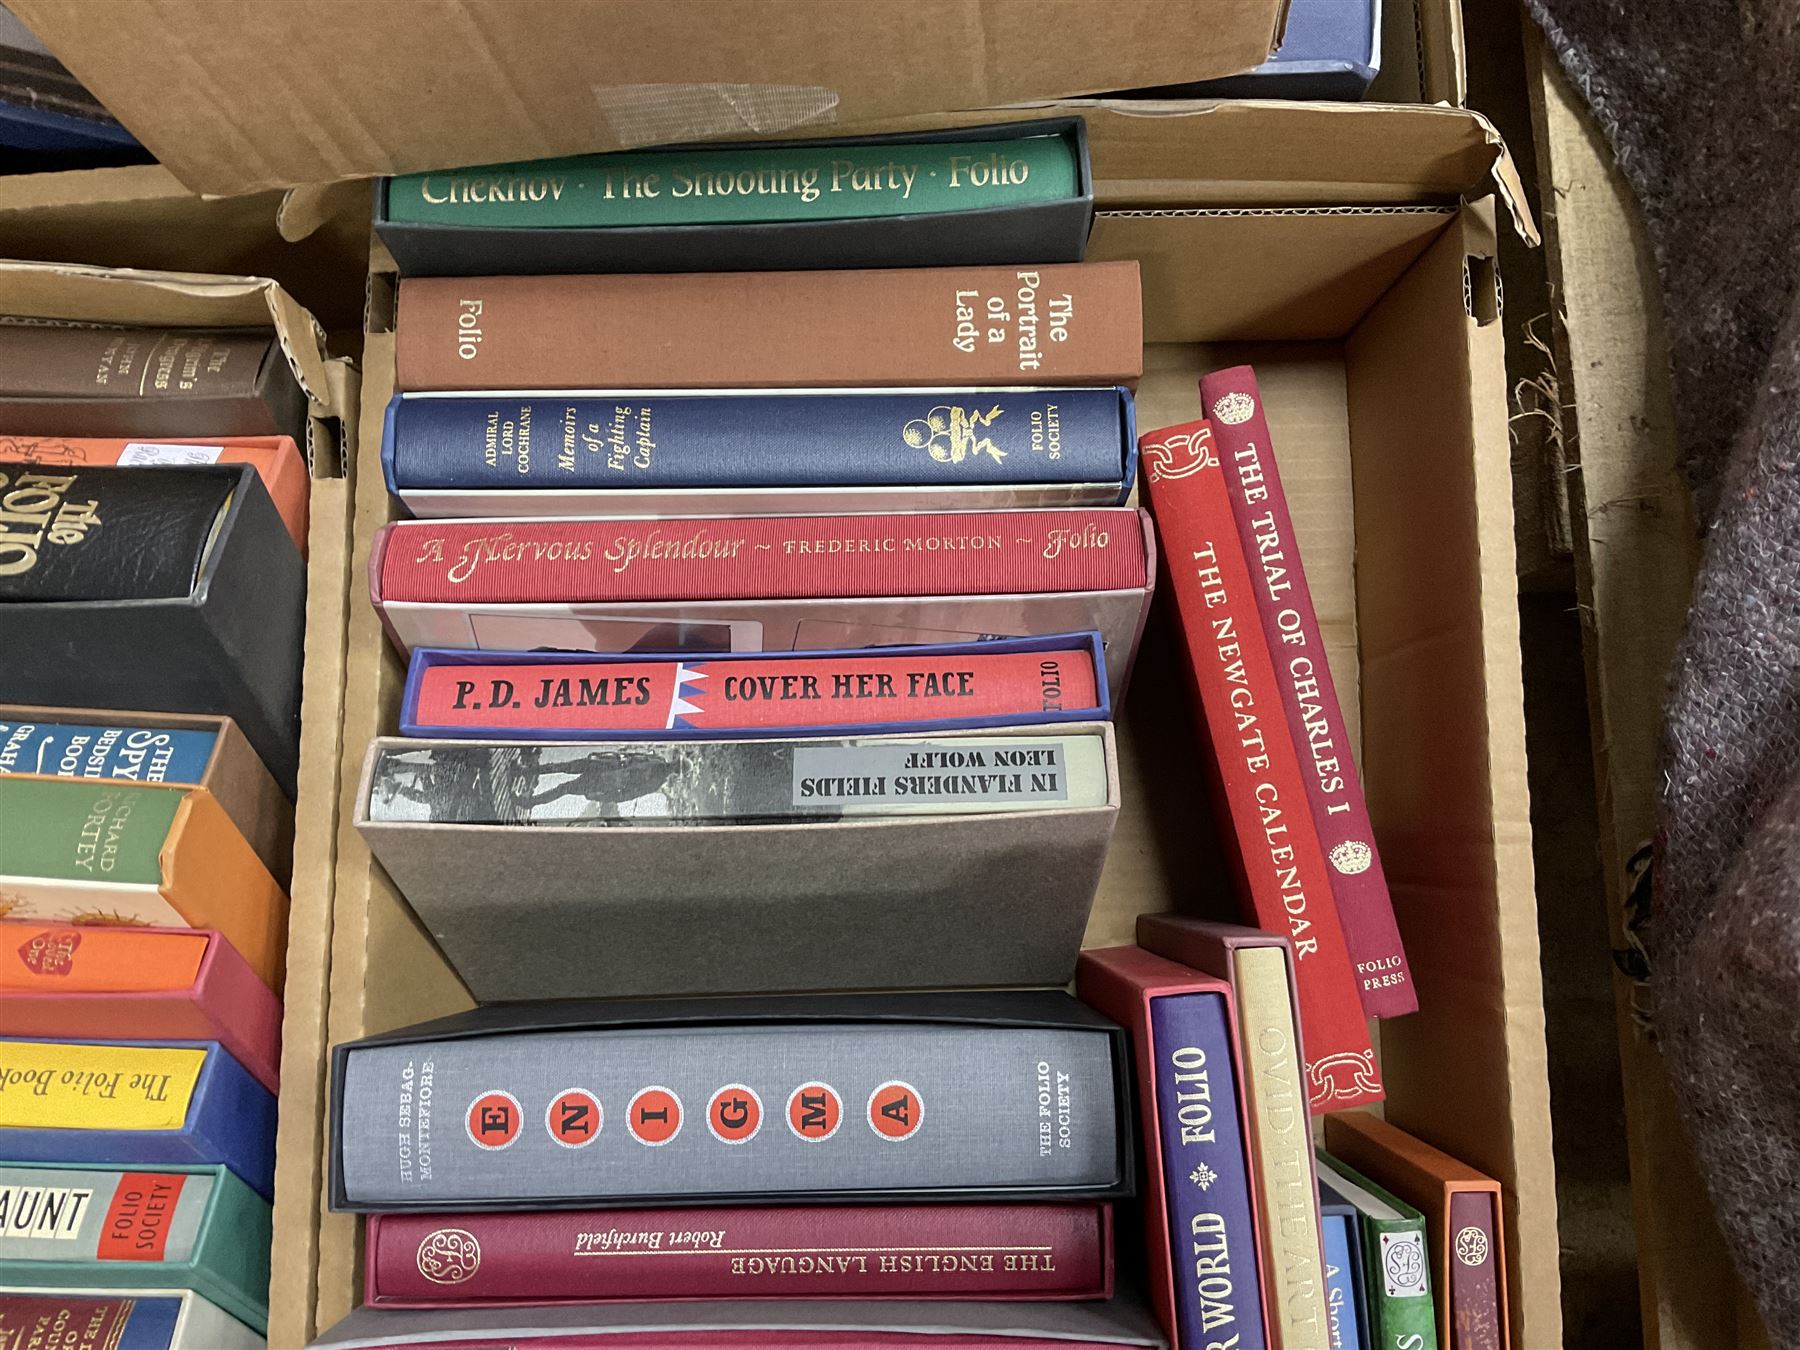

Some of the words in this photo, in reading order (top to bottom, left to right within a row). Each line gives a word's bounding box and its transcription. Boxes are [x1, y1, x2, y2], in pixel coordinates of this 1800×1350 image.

[603, 165, 661, 199] The
[672, 163, 820, 202] Shooting
[830, 160, 918, 199] Party
[949, 154, 1030, 188] Folio
[459, 299, 483, 359] Folio
[952, 290, 980, 352] Lady
[987, 296, 1011, 321] of
[1017, 271, 1043, 371] Portrait
[1049, 293, 1073, 342] The
[988, 329, 1006, 343] a
[485, 411, 499, 467] ADMIRAL
[502, 420, 514, 456] LORD
[518, 405, 532, 473] COCHRANE
[558, 407, 577, 473] Memoirs
[582, 434, 604, 452] of
[589, 423, 600, 434] a
[608, 406, 631, 471] Fighting
[633, 407, 656, 470] Captain
[1031, 411, 1043, 451] FOLIO
[1047, 404, 1061, 460] SOCIETY
[1234, 442, 1268, 505] THE
[0, 471, 78, 577] FOLIO
[47, 500, 102, 545] The
[416, 538, 446, 564] A
[448, 533, 594, 584] Nervous
[604, 529, 745, 573] Splendour
[783, 538, 896, 554] FREDERIC
[904, 535, 1002, 551] MORTON
[1043, 523, 1109, 559] Folio
[1252, 511, 1292, 601] TRIAL
[1277, 609, 1306, 646] OF
[534, 676, 650, 708] JAMES
[724, 674, 819, 701] COVER
[832, 673, 897, 699] HER
[907, 672, 974, 698] FACE
[1040, 660, 1062, 711] FOLIO
[1289, 656, 1344, 793] CHARLES
[112, 730, 170, 780] SPY
[147, 747, 174, 782] THE
[905, 751, 987, 769] WOLFF
[994, 750, 1057, 768] LEON
[1193, 541, 1227, 608] THE
[1212, 617, 1270, 773] NEWGATE
[1255, 782, 1318, 961] CALENDAR
[800, 776, 886, 798] FIELDS
[894, 774, 1023, 796] FLANDERS
[1030, 773, 1058, 794] IN
[1327, 801, 1350, 815] I
[1356, 956, 1402, 974] FOLIO
[1363, 971, 1405, 991] PRESS
[61, 1070, 125, 1099] Folio
[131, 1074, 171, 1102] The
[399, 1061, 414, 1128] SEBAG-
[1038, 1061, 1051, 1116] FOLIO
[1172, 1047, 1216, 1146] FOLIO
[1259, 1027, 1296, 1134] OVID
[418, 1061, 435, 1181] MONTEFIORE
[1057, 1071, 1071, 1148] SOCIETY
[400, 1135, 414, 1183] HUGH
[1039, 1121, 1052, 1156] THE
[112, 1191, 144, 1239] FOLIO
[136, 1183, 172, 1249] SOCIETY
[1273, 1150, 1308, 1238] THE
[575, 1229, 664, 1250] Burchfield
[669, 1231, 726, 1248] Robert
[879, 1255, 994, 1272] ENGLISH
[1004, 1255, 1056, 1272] THE
[731, 1256, 868, 1275] LANGUAGE
[1191, 1212, 1236, 1334] WORLD
[1283, 1247, 1320, 1334] ART
[27, 1317, 51, 1350] PAR
[84, 1306, 108, 1339] THE
